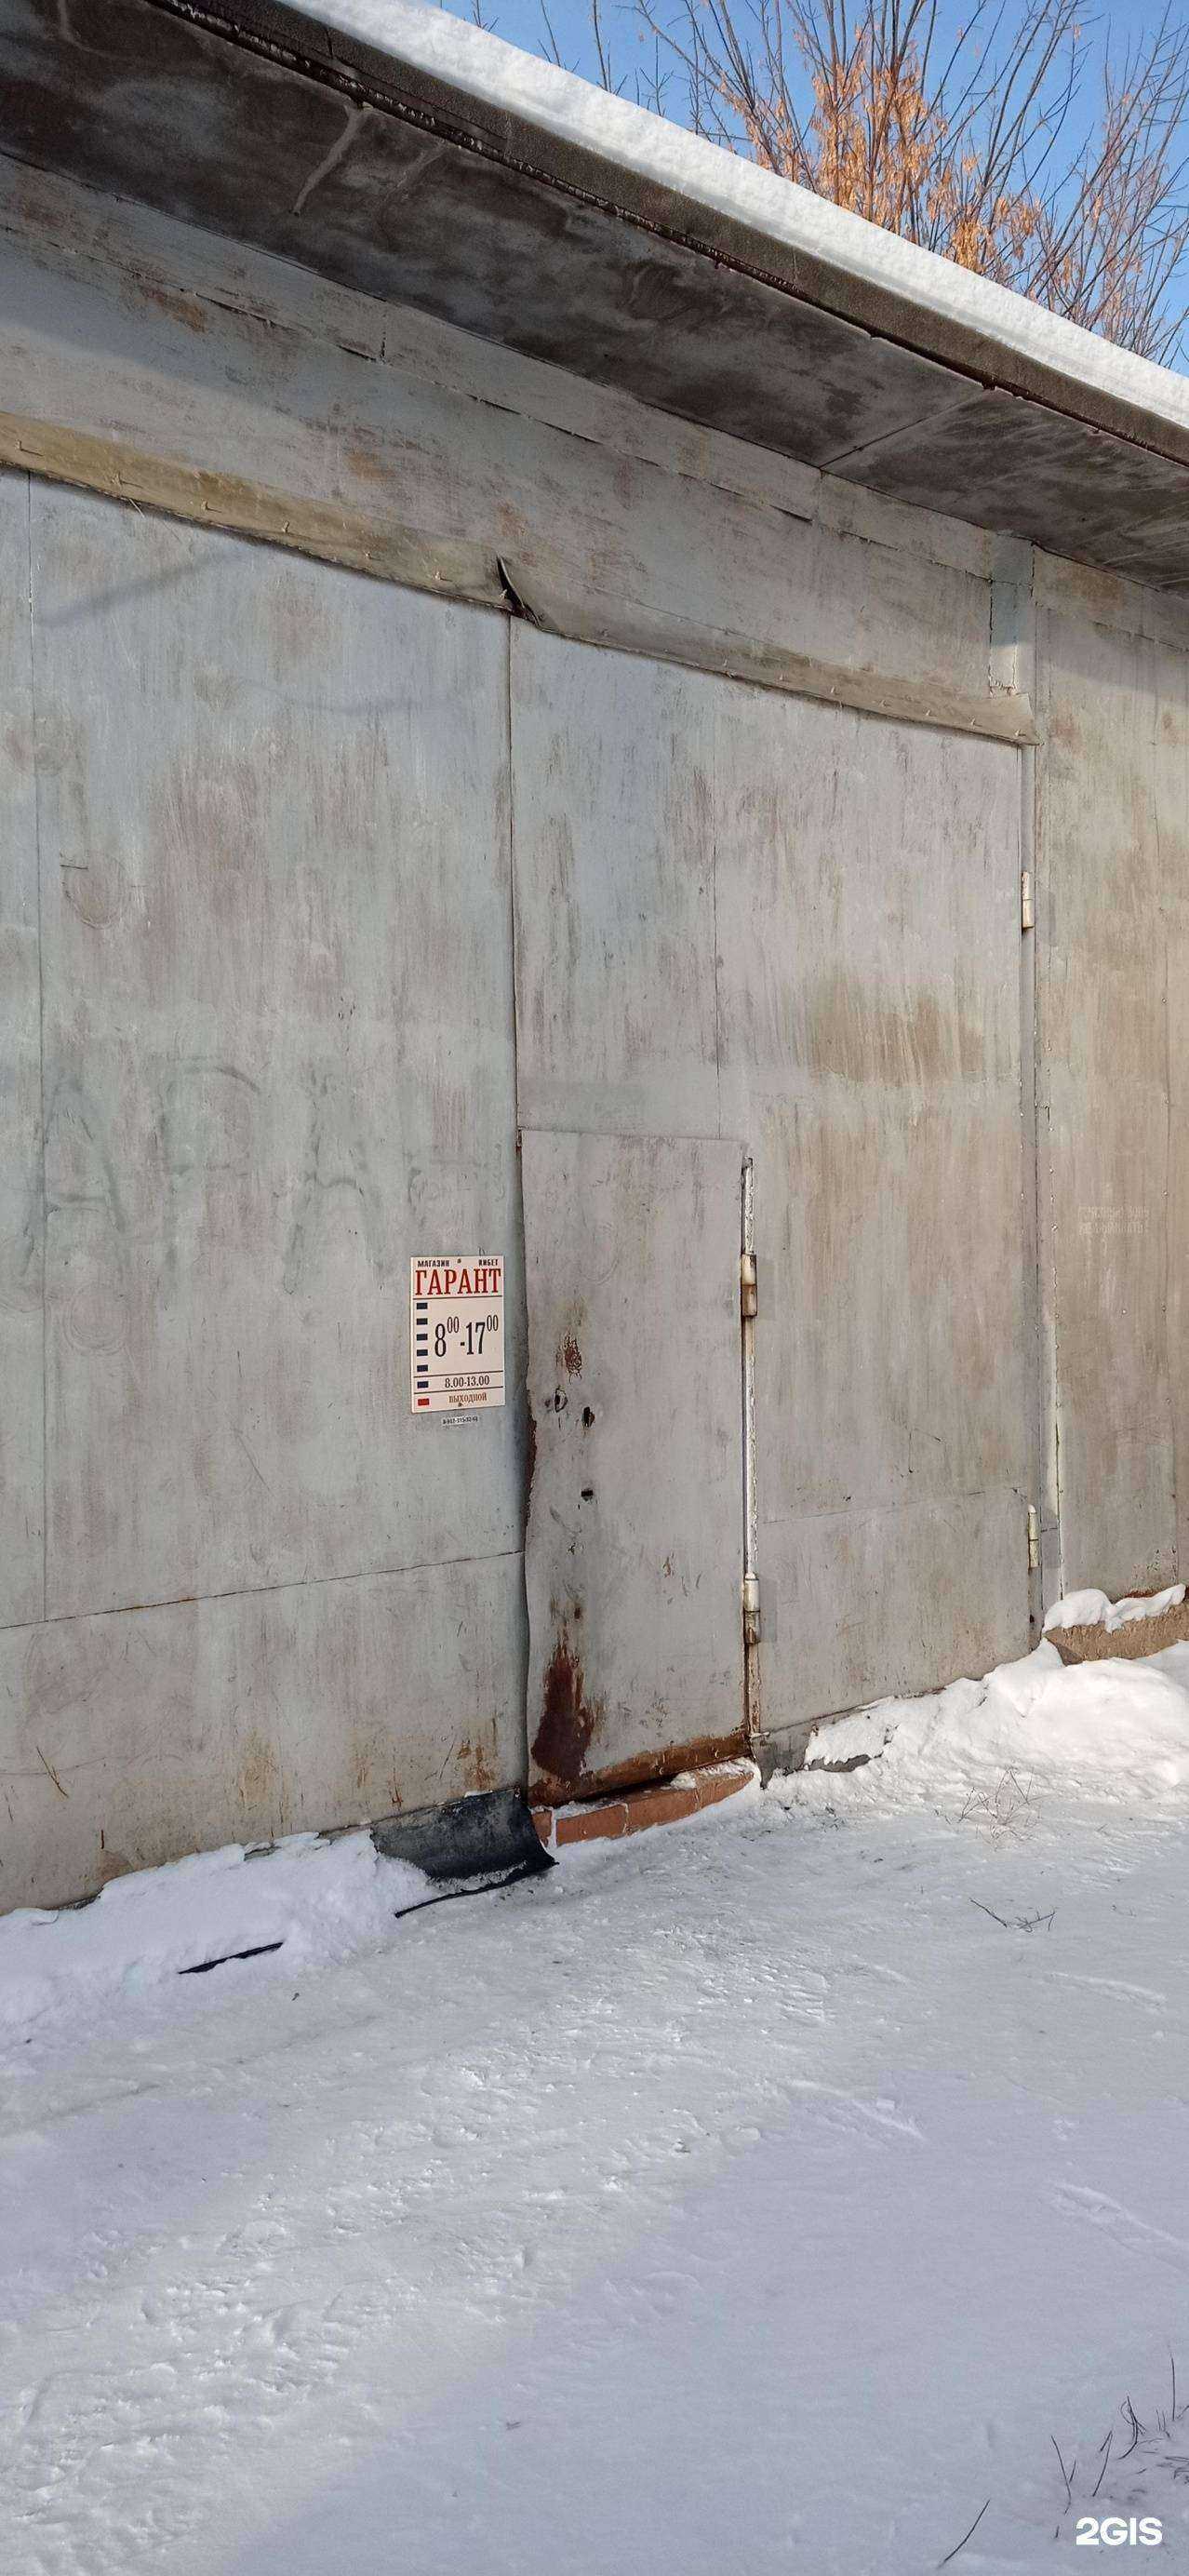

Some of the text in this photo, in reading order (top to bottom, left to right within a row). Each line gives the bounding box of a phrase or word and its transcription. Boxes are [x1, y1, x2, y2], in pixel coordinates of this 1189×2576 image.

[415, 1268, 501, 1295] ГАРАНТ
[445, 1375, 490, 1388] 8.00-13.00
[448, 1391, 488, 1403] ВЫХОДНОЙ
